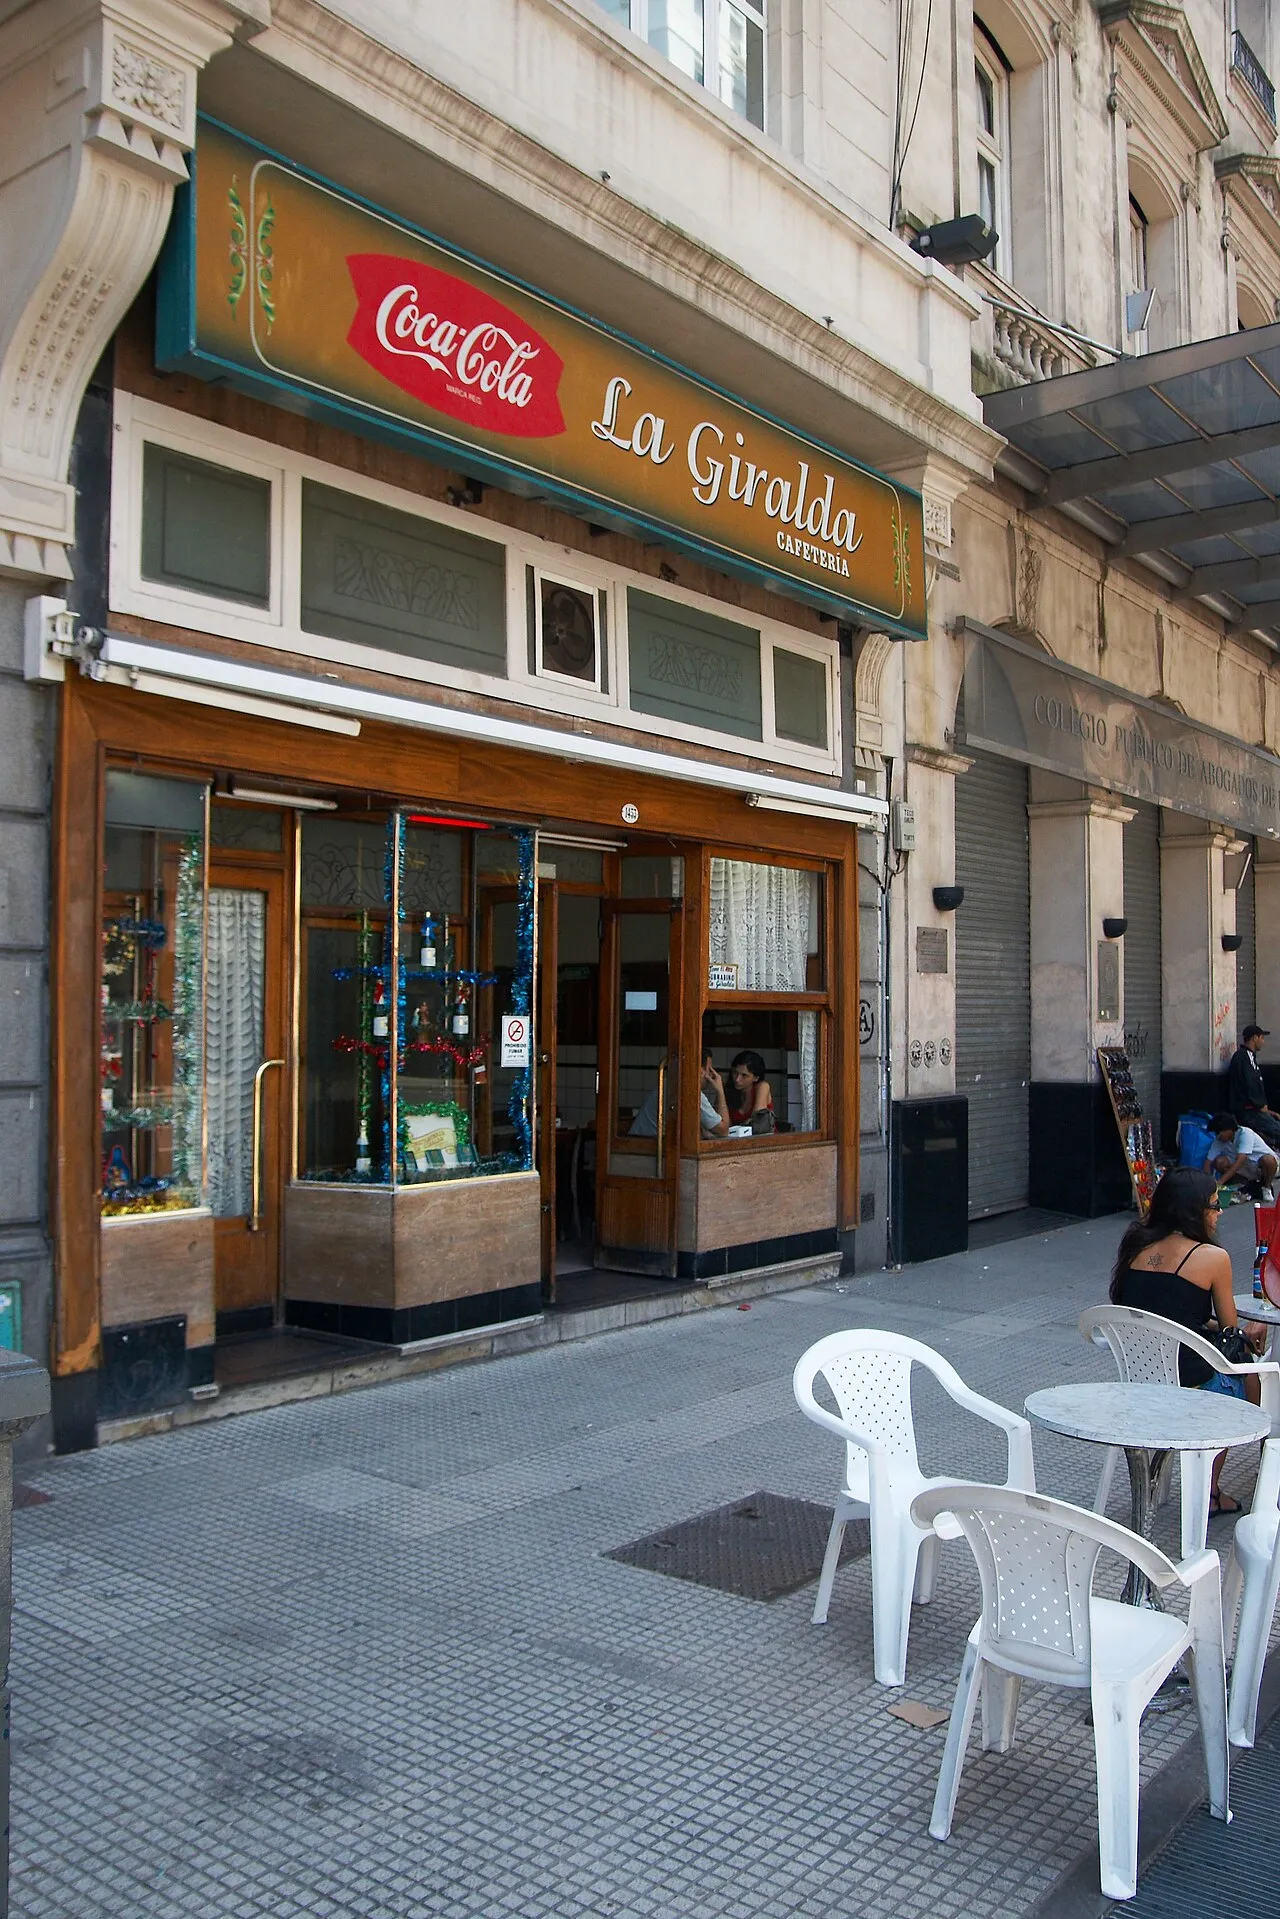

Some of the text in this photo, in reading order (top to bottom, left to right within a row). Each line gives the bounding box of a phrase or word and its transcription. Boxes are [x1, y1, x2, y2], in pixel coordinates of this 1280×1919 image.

[374, 283, 541, 409] Coca-Cola
[590, 375, 864, 553] La Giralda
[776, 530, 851, 578] CAFETERÍA
[1033, 693, 1107, 746] COLEGIO
[1177, 750, 1195, 778] DE
[1200, 759, 1259, 805] ABOGADOS
